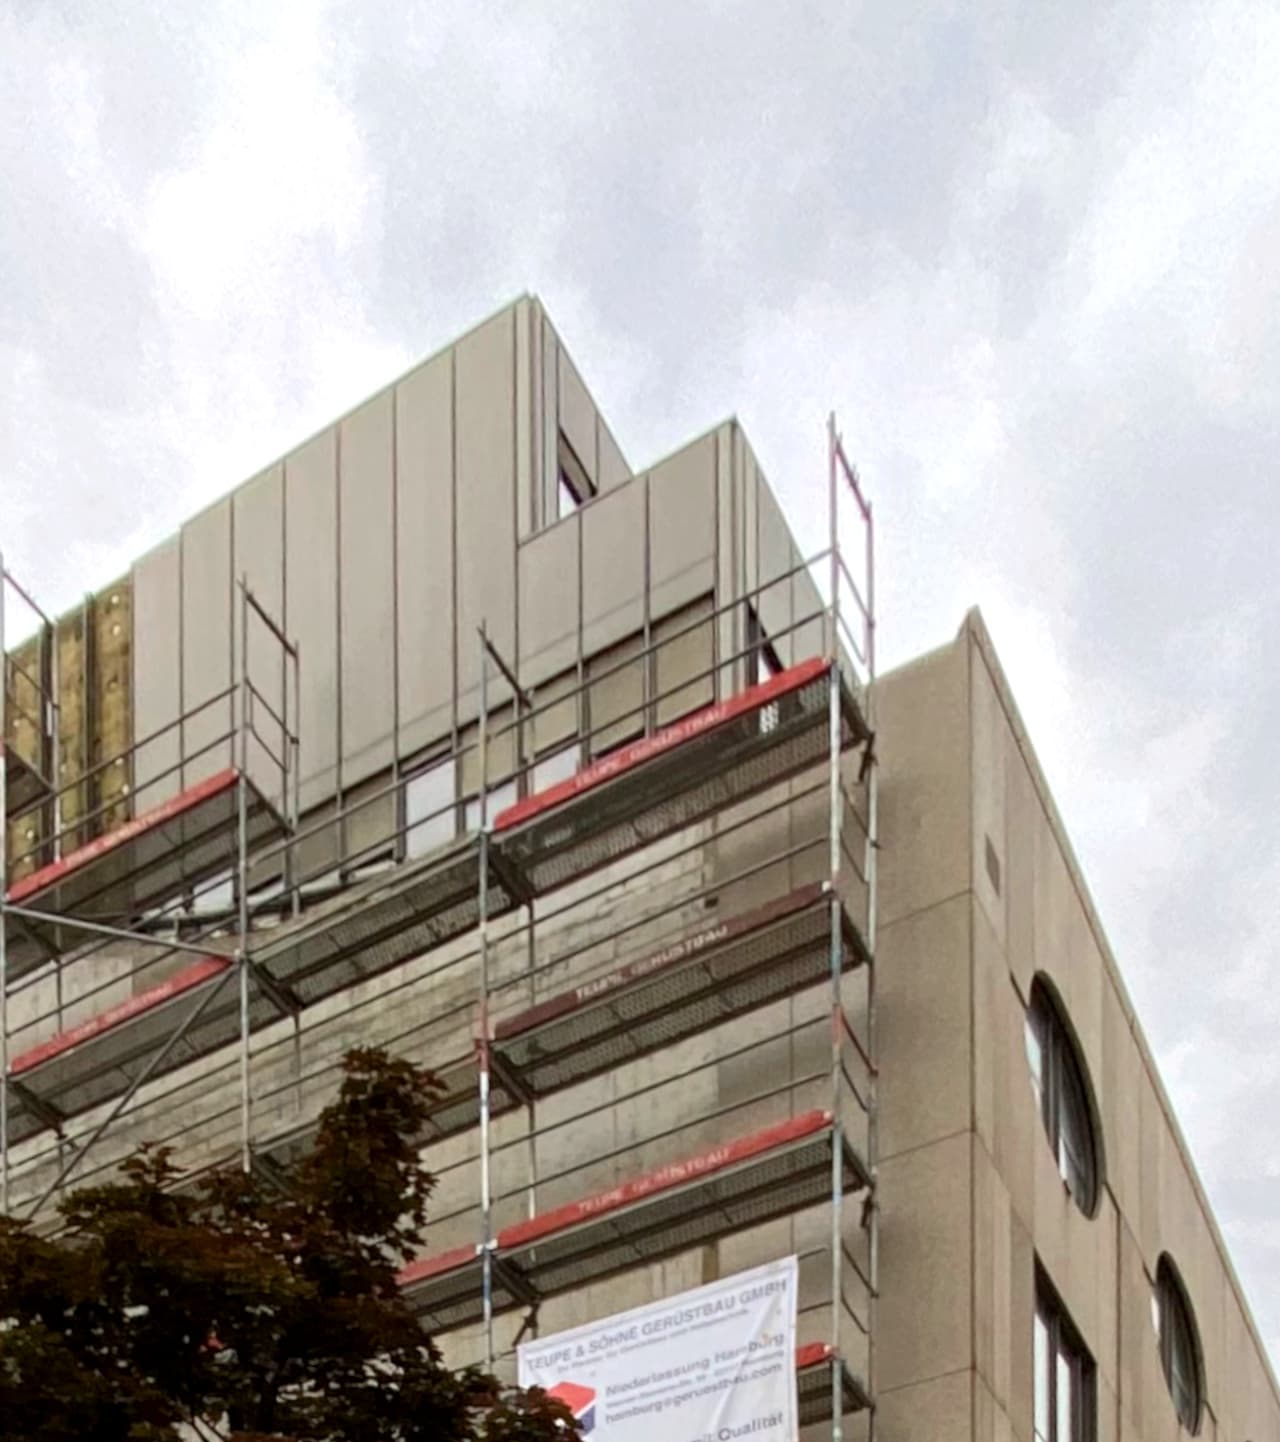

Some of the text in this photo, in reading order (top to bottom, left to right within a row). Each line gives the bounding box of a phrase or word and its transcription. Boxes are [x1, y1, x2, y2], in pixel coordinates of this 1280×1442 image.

[527, 1279, 787, 1371] TEUPE & SÖHNE GERÜSTBAU GMBH
[605, 1357, 710, 1397] Niederlassung
[714, 1332, 785, 1363] Hamburg
[717, 1411, 783, 1442] Qualität
